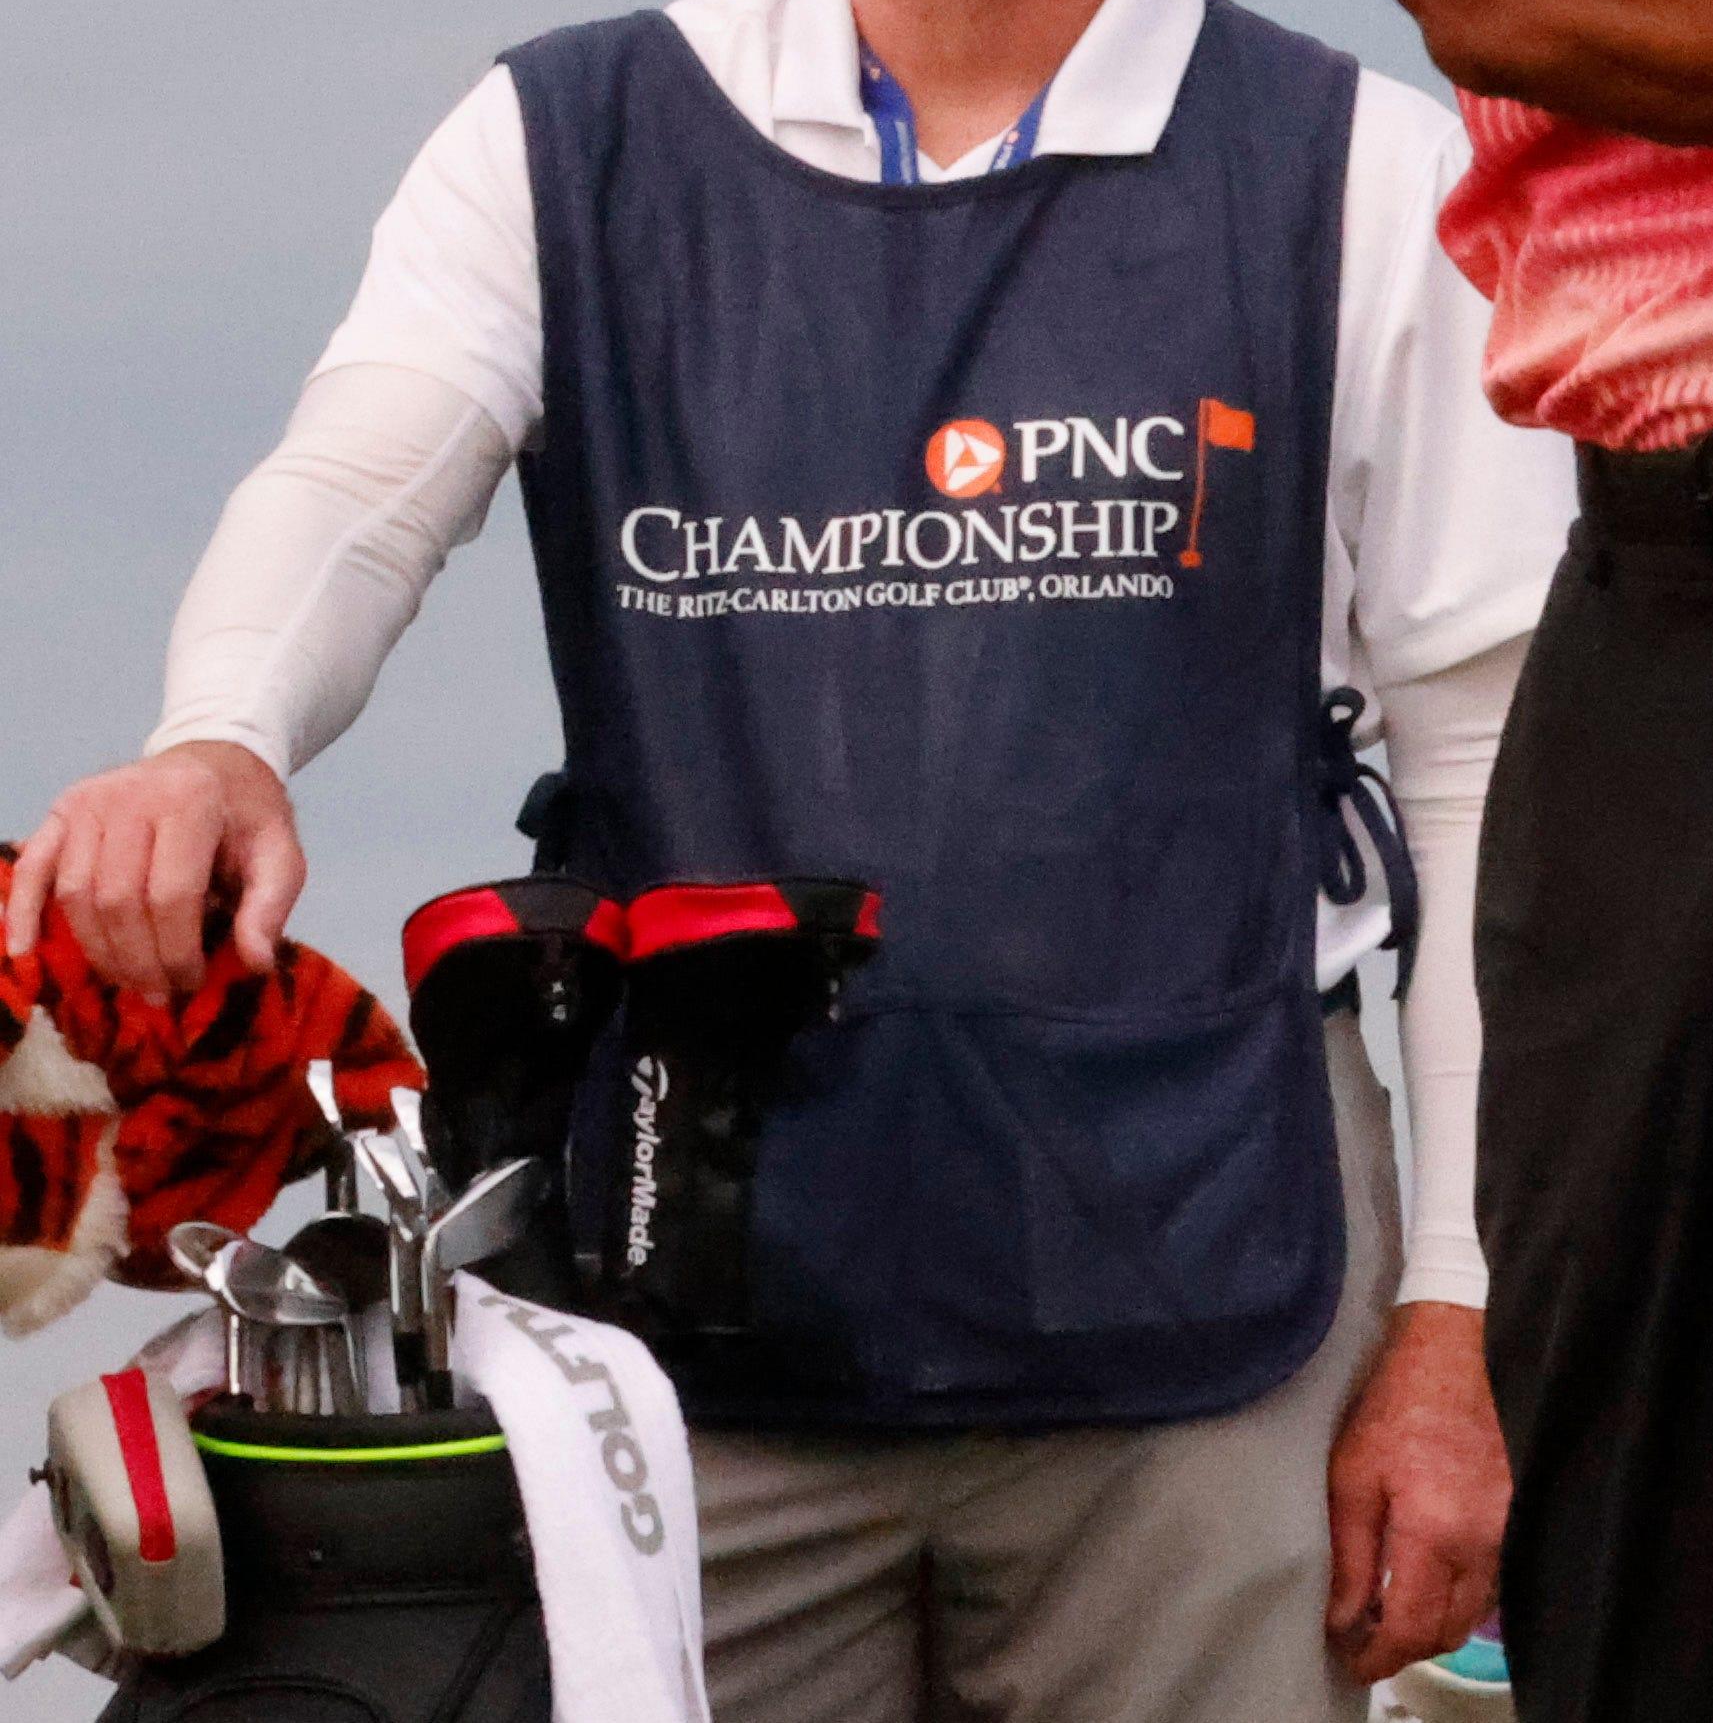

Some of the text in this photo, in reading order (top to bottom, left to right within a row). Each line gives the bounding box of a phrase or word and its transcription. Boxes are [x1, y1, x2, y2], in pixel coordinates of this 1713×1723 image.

[1013, 414, 1185, 483] PNC
[619, 499, 1181, 582] CHAMPIONSHIP
[616, 584, 672, 617] THE
[677, 584, 864, 619] RITZ-CARLTON
[866, 581, 941, 607] GOLF
[1039, 573, 1175, 600] ORLANDO
[626, 1055, 670, 1267] TaylorMade
